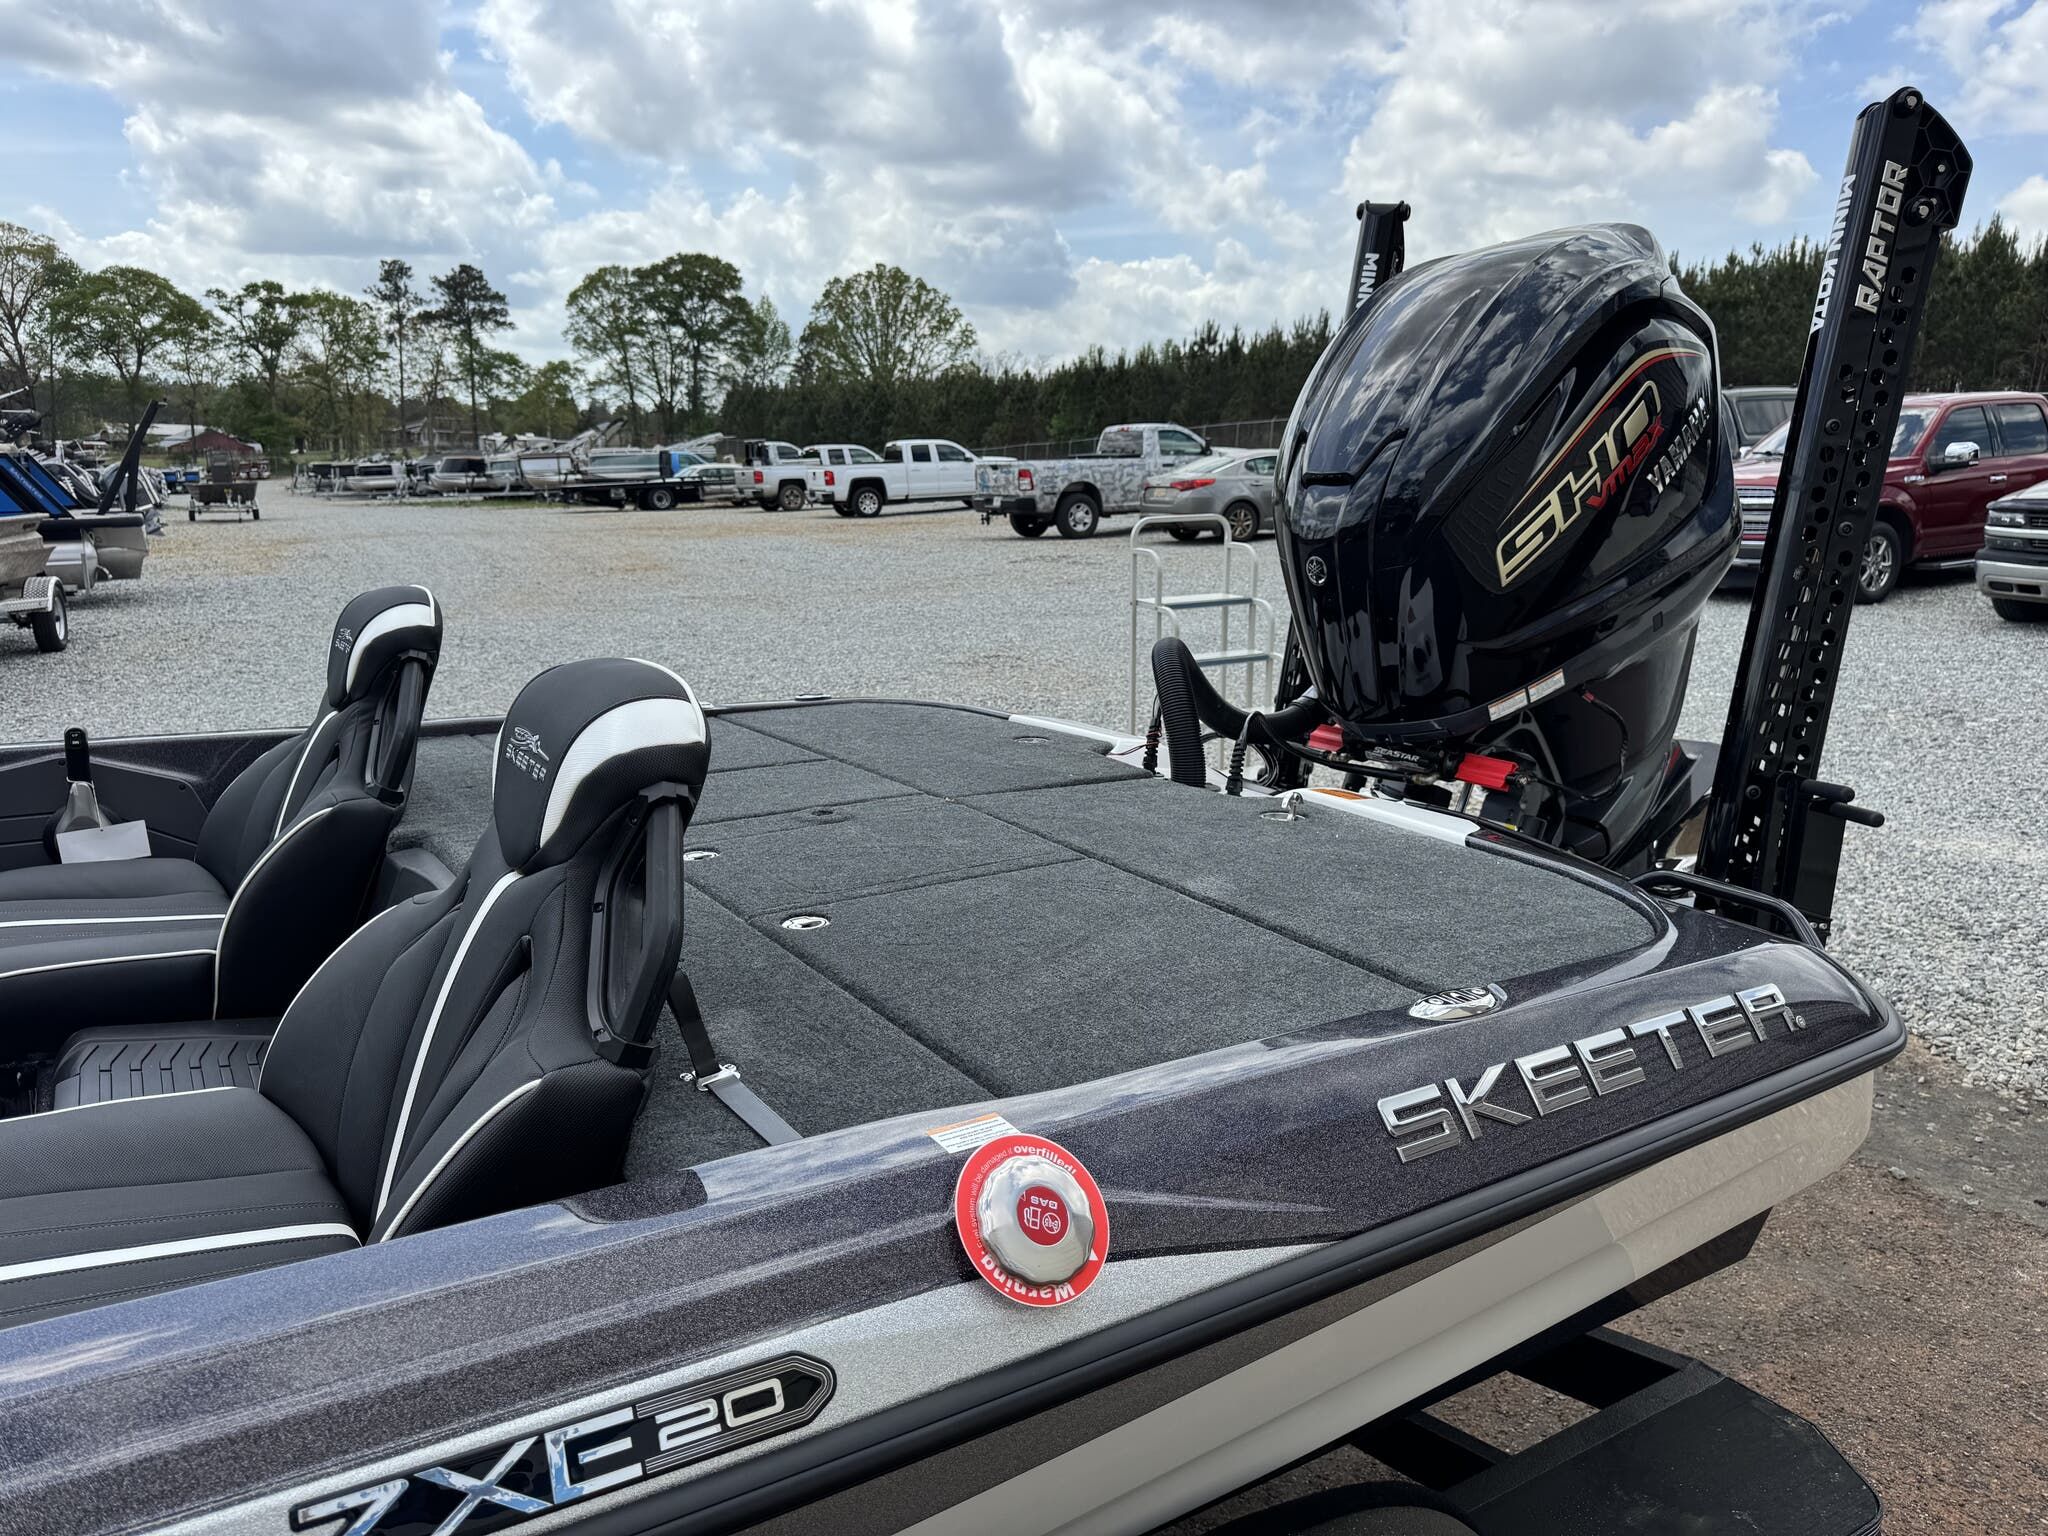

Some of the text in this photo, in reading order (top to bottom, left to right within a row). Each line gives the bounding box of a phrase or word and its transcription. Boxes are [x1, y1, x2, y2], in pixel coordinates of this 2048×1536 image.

[1855, 160, 1908, 314] RAPTOR
[1810, 257, 1838, 334] KOTA
[1646, 397, 1710, 494] YAMAHA
[1496, 380, 1662, 587] SHO
[506, 743, 547, 782] SKEETER
[1373, 746, 1420, 762] SEASTAR
[975, 1173, 984, 1183] be
[980, 1150, 1008, 1173] damaged
[1030, 1195, 1058, 1210] GAS
